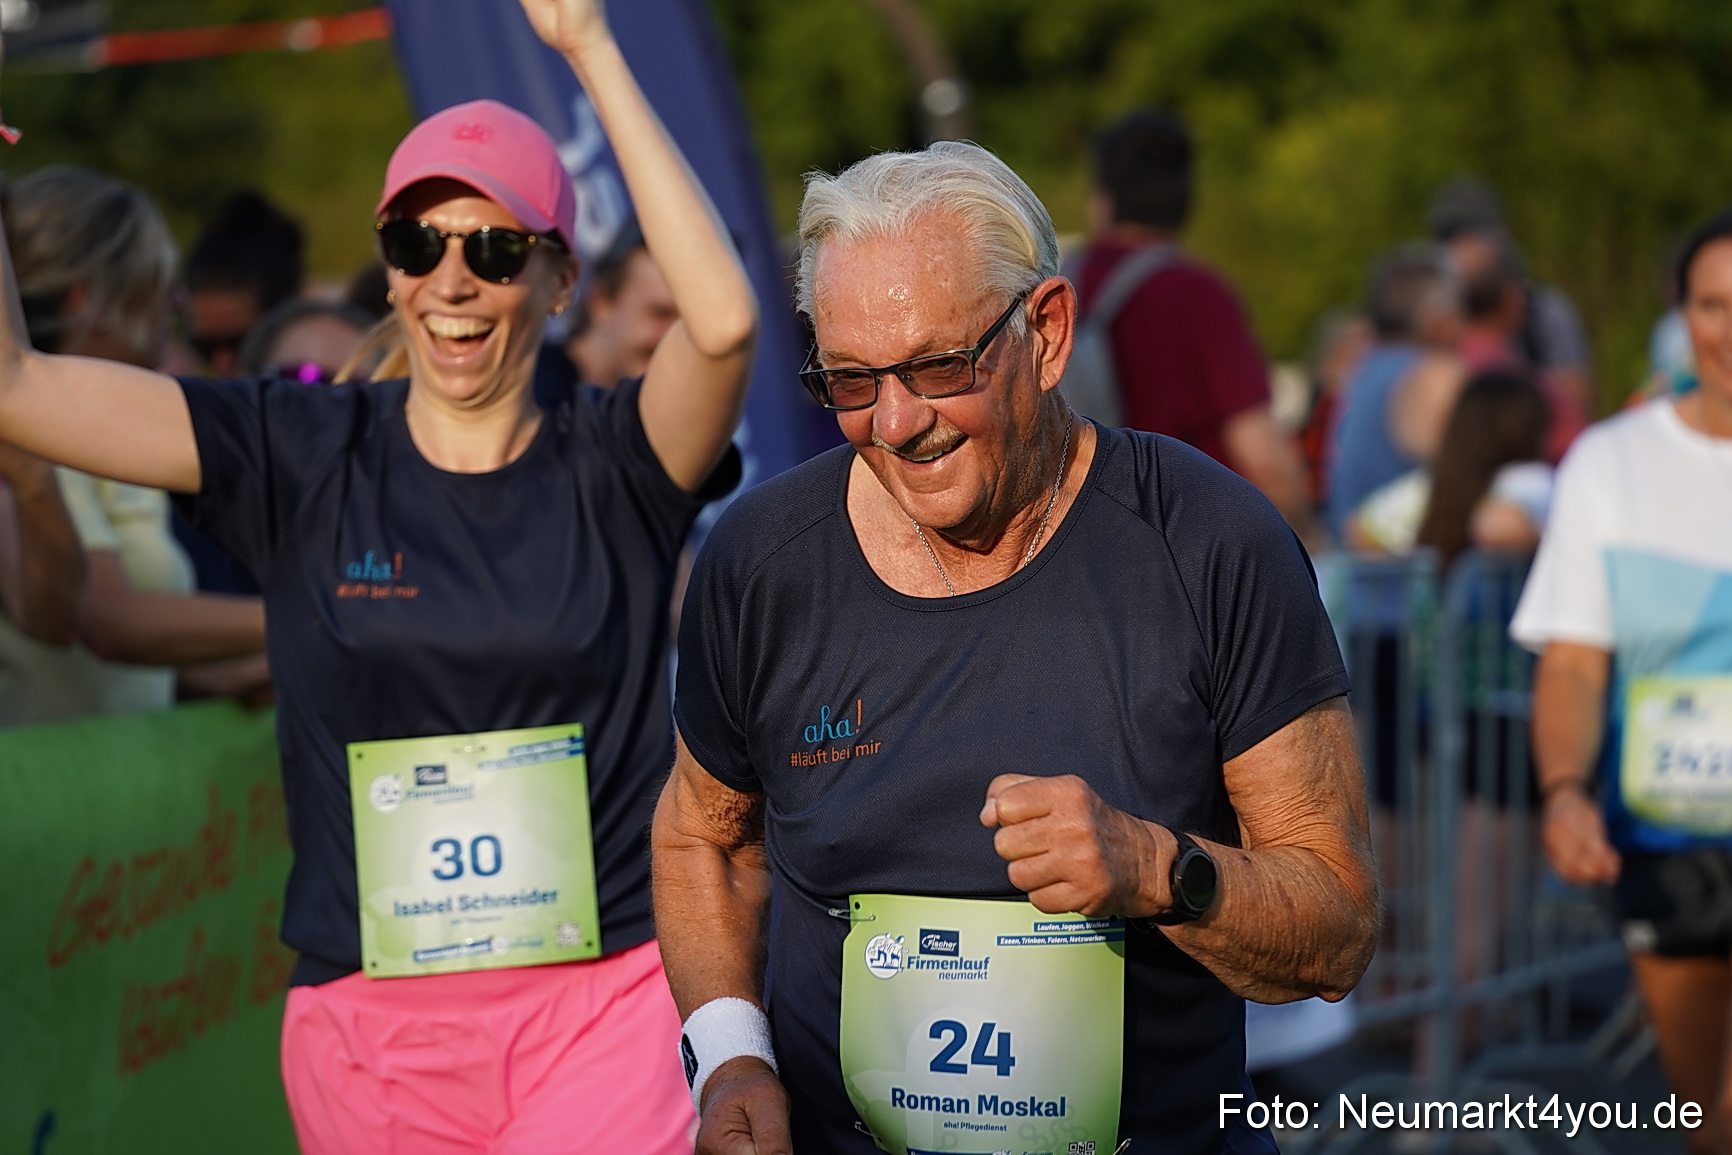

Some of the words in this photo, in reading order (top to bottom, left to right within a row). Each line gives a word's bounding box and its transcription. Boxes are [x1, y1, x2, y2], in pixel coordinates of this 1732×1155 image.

[346, 550, 403, 580] aha!
[804, 698, 863, 743] aha!
[791, 749, 829, 767] #läuft
[831, 745, 851, 762] bei
[855, 740, 881, 757] mir
[431, 834, 503, 881] 30
[393, 894, 453, 917] Isabel
[458, 889, 558, 912] Schneider
[921, 934, 958, 949] Fischer
[906, 956, 991, 971] Firmenlauf
[938, 970, 989, 980] neumarkt
[929, 1020, 1016, 1077] 24
[891, 1087, 970, 1114] Roman
[977, 1094, 1066, 1117] Moskal
[960, 1122, 1008, 1132] Pflegedienst
